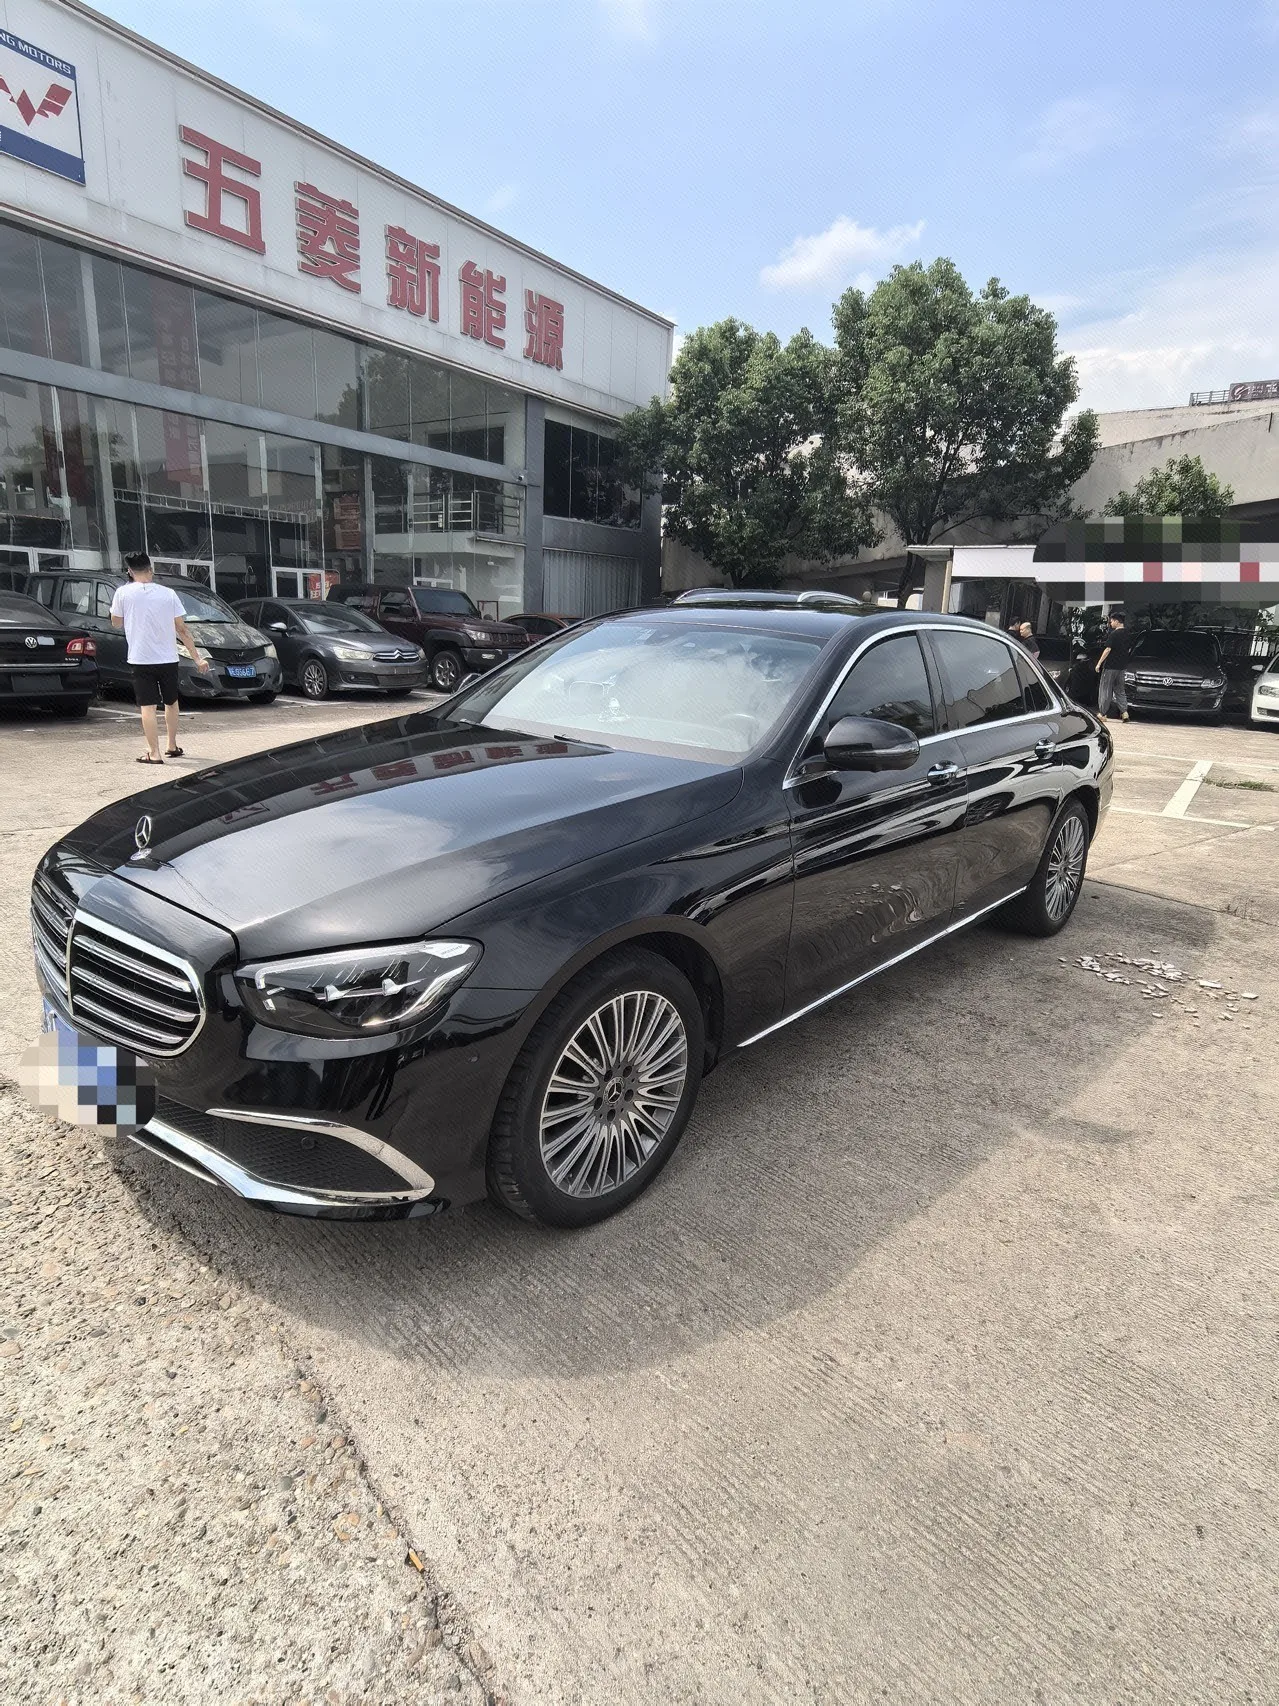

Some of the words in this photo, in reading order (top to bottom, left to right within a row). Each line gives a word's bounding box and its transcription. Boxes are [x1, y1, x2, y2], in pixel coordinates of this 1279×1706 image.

[18, 41, 71, 75] MOTORS
[178, 124, 566, 371] 五菱新能源
